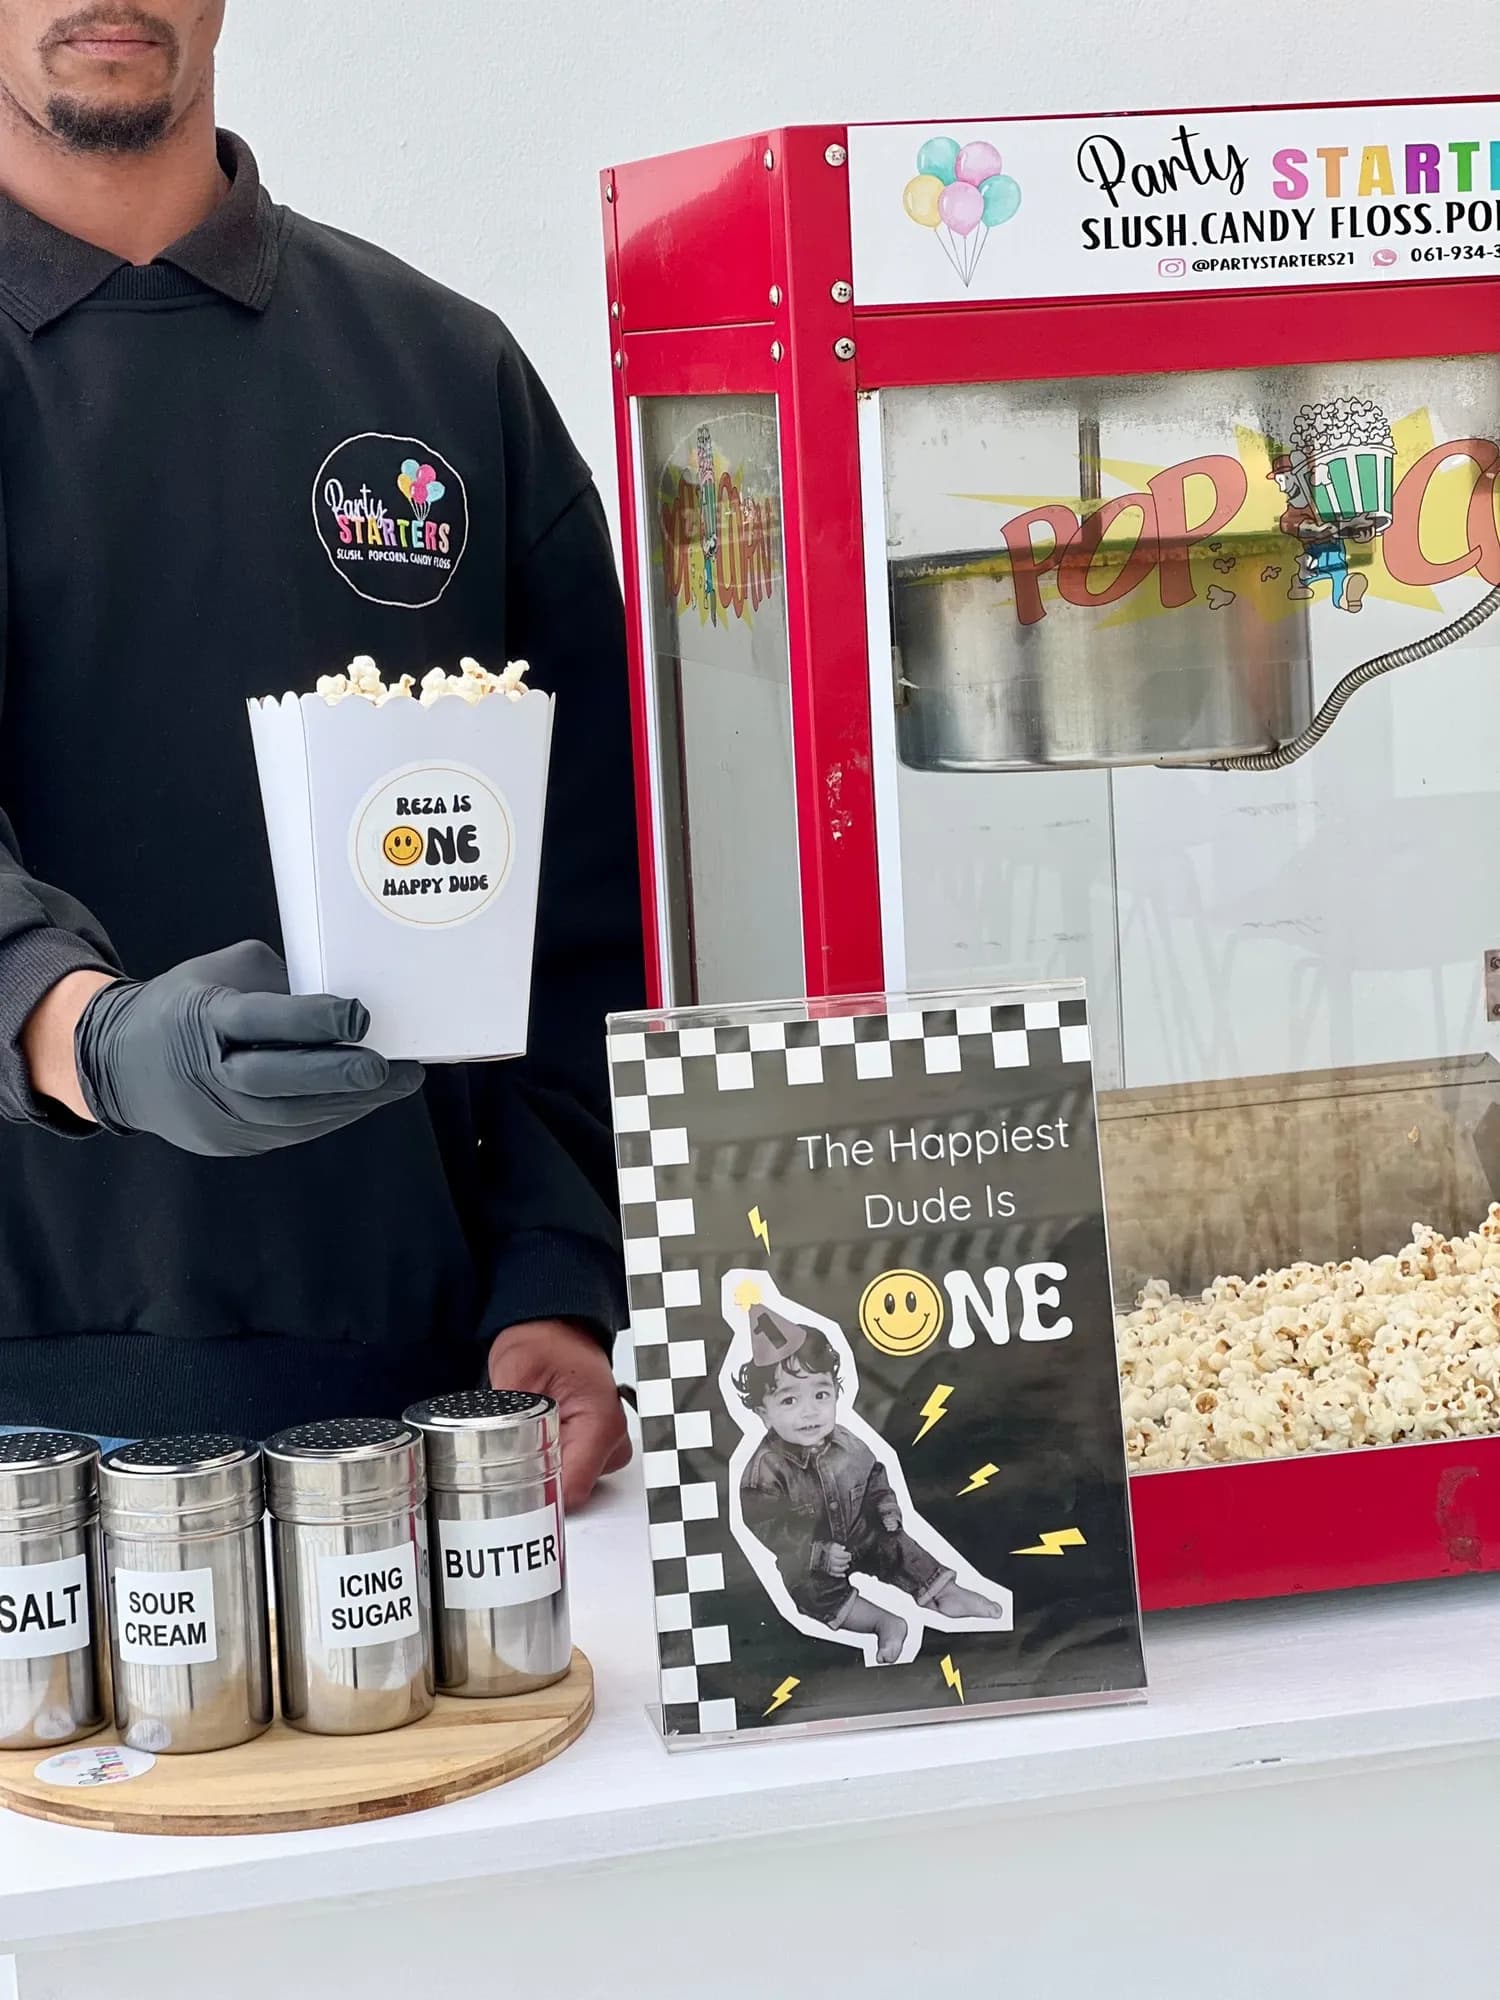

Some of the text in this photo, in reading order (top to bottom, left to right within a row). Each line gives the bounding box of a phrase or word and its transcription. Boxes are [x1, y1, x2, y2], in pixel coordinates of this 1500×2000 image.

[1077, 124, 1249, 208] Party
[1330, 199, 1500, 239] FLOSS.PO
[1191, 252, 1355, 273] @PARTYSTARTERS21
[324, 478, 389, 529] Party
[336, 514, 451, 554] STARTERS
[1000, 454, 1248, 626] POP
[410, 552, 433, 567] CANDY
[433, 556, 452, 570] FLOSS
[396, 794, 472, 816] REZA IS
[383, 874, 489, 896] HAPPY DUDE
[797, 1117, 1070, 1170] The Happiest
[864, 1184, 1016, 1229] Dude Is
[445, 1534, 557, 1579] BUTTER
[339, 1566, 403, 1599] ICING
[0, 1583, 81, 1634] SALT
[128, 1591, 196, 1615] SOUR
[331, 1595, 413, 1631] SUGAR
[125, 1621, 207, 1647] CREAM
